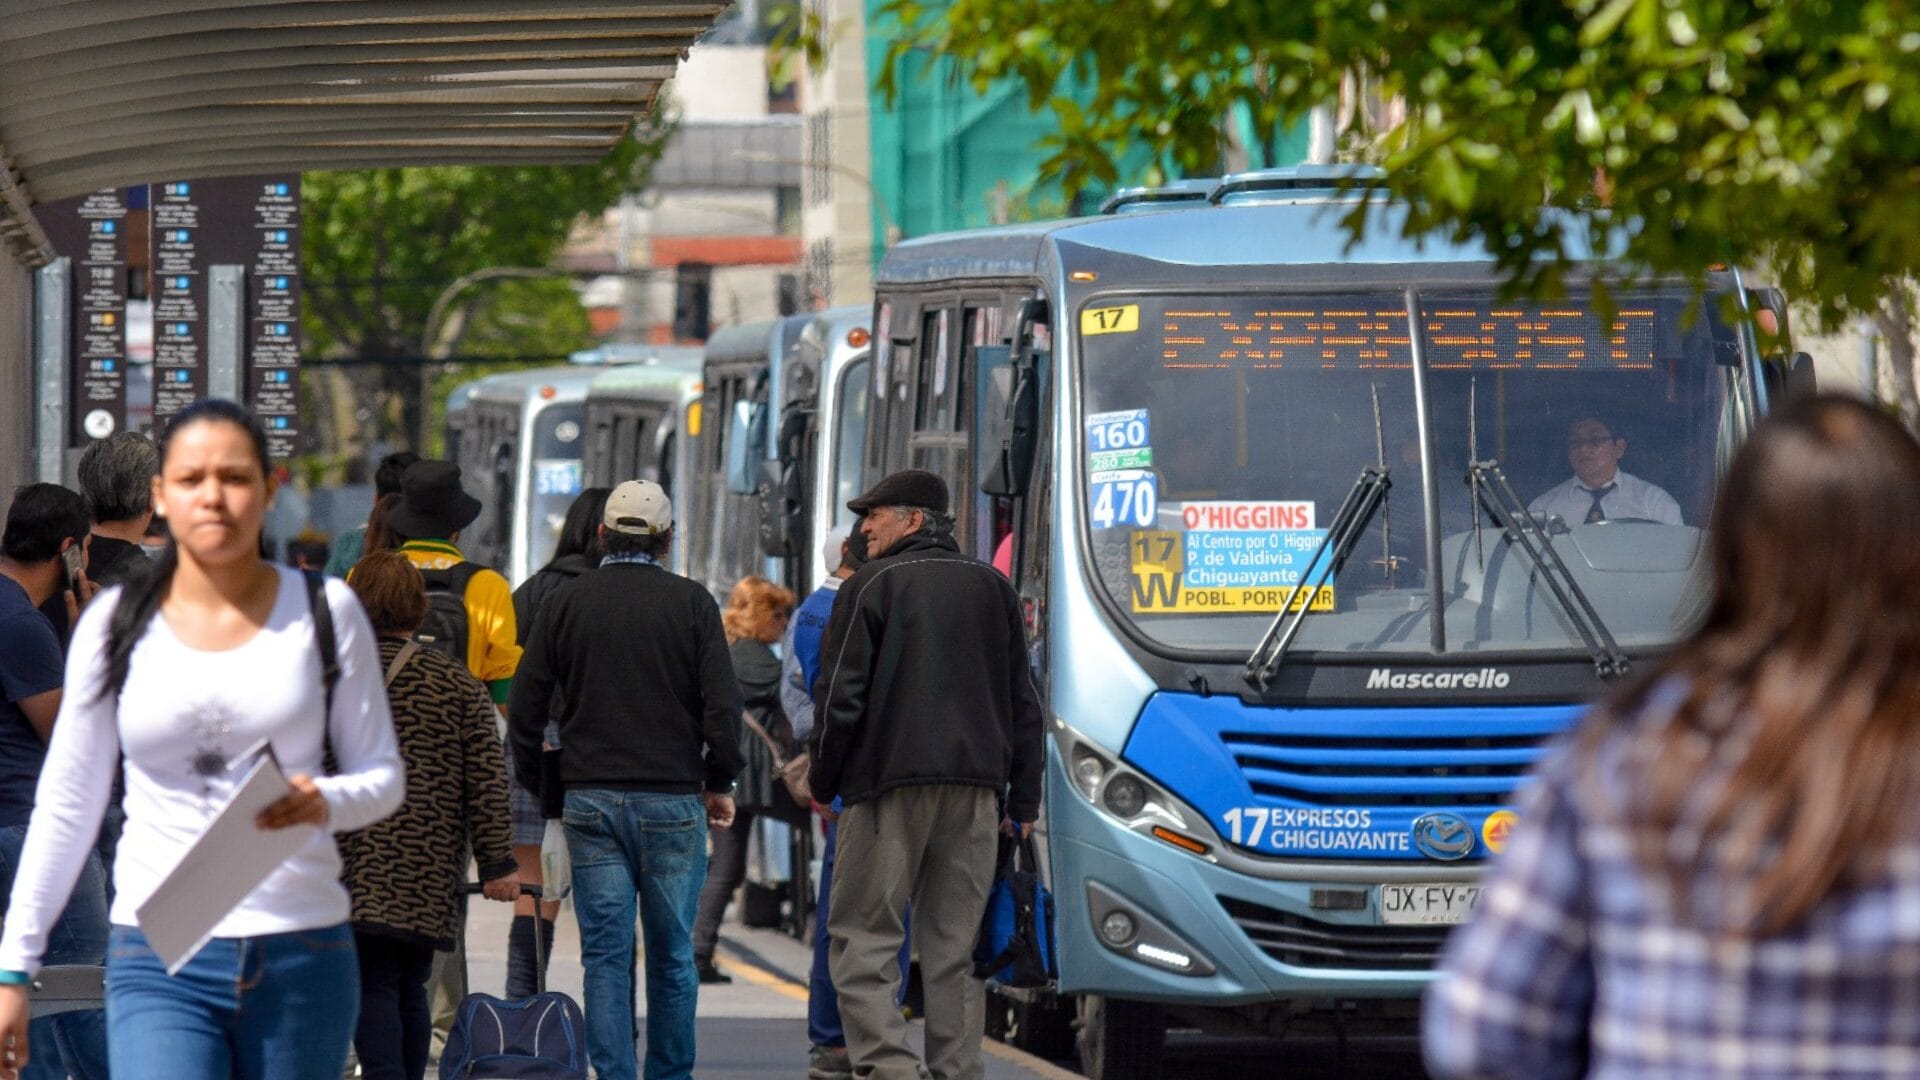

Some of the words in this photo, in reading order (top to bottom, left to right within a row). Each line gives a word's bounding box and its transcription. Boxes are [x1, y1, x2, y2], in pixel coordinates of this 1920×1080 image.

[1093, 308, 1124, 329] 17
[1163, 310, 1585, 369] EXPRESOS
[1092, 420, 1145, 449] 160
[1093, 480, 1155, 528] 470
[1183, 505, 1308, 529] O'HIGGINS
[1135, 537, 1176, 563] 17
[1202, 533, 1242, 549] Centro
[1245, 537, 1266, 552] por
[1187, 552, 1199, 566] P.
[1204, 551, 1225, 566] de
[1229, 551, 1293, 566] Valdivia
[1188, 567, 1299, 587] Chiguayante
[1131, 573, 1182, 608] W
[1185, 590, 1236, 606] POBL.
[1366, 668, 1511, 689] Mascarello
[1222, 806, 1269, 847] 17
[1271, 808, 1371, 829] EXPRESOS
[1270, 829, 1410, 851] CHIGUAYANTE
